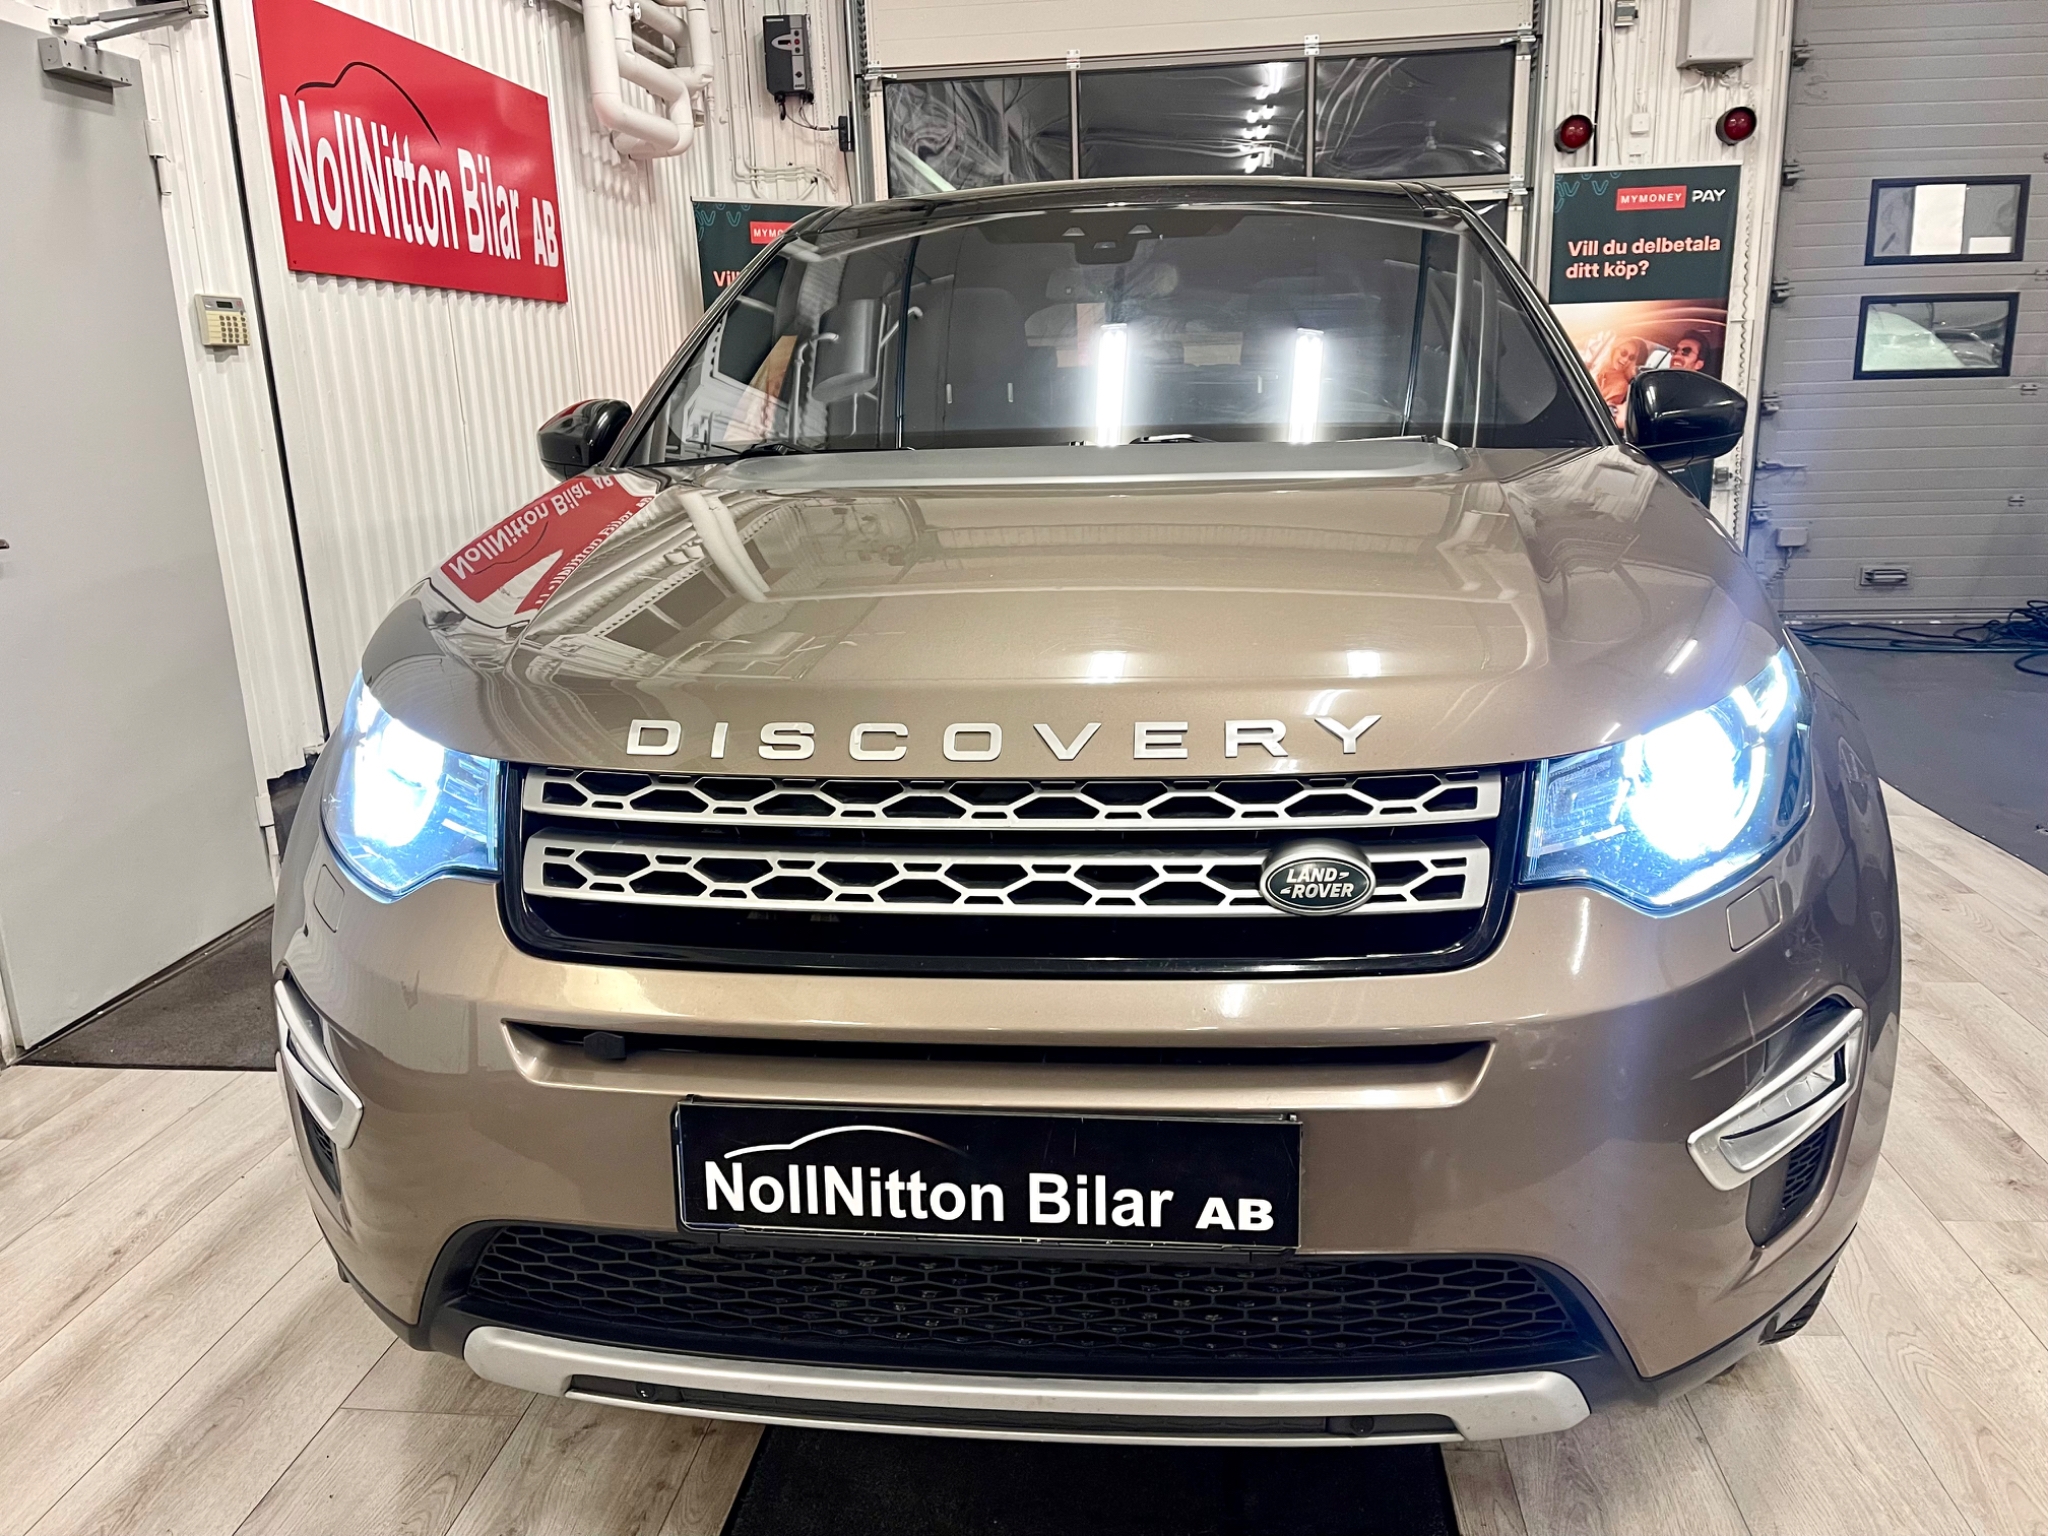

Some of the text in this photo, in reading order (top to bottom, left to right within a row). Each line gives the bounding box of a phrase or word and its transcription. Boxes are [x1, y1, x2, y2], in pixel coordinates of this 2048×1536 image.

[279, 94, 559, 267] NollNitton Bilar AB
[1620, 189, 1726, 204] MYMONEY PAY
[1568, 236, 1721, 257] Vill du delbetala
[1565, 260, 1650, 280] ditt köp?
[626, 714, 1383, 761] DISCOVERY
[1286, 867, 1338, 883] LAND
[1291, 882, 1354, 899] ROVER
[704, 1160, 1275, 1231] NollNitton Bilar AB
